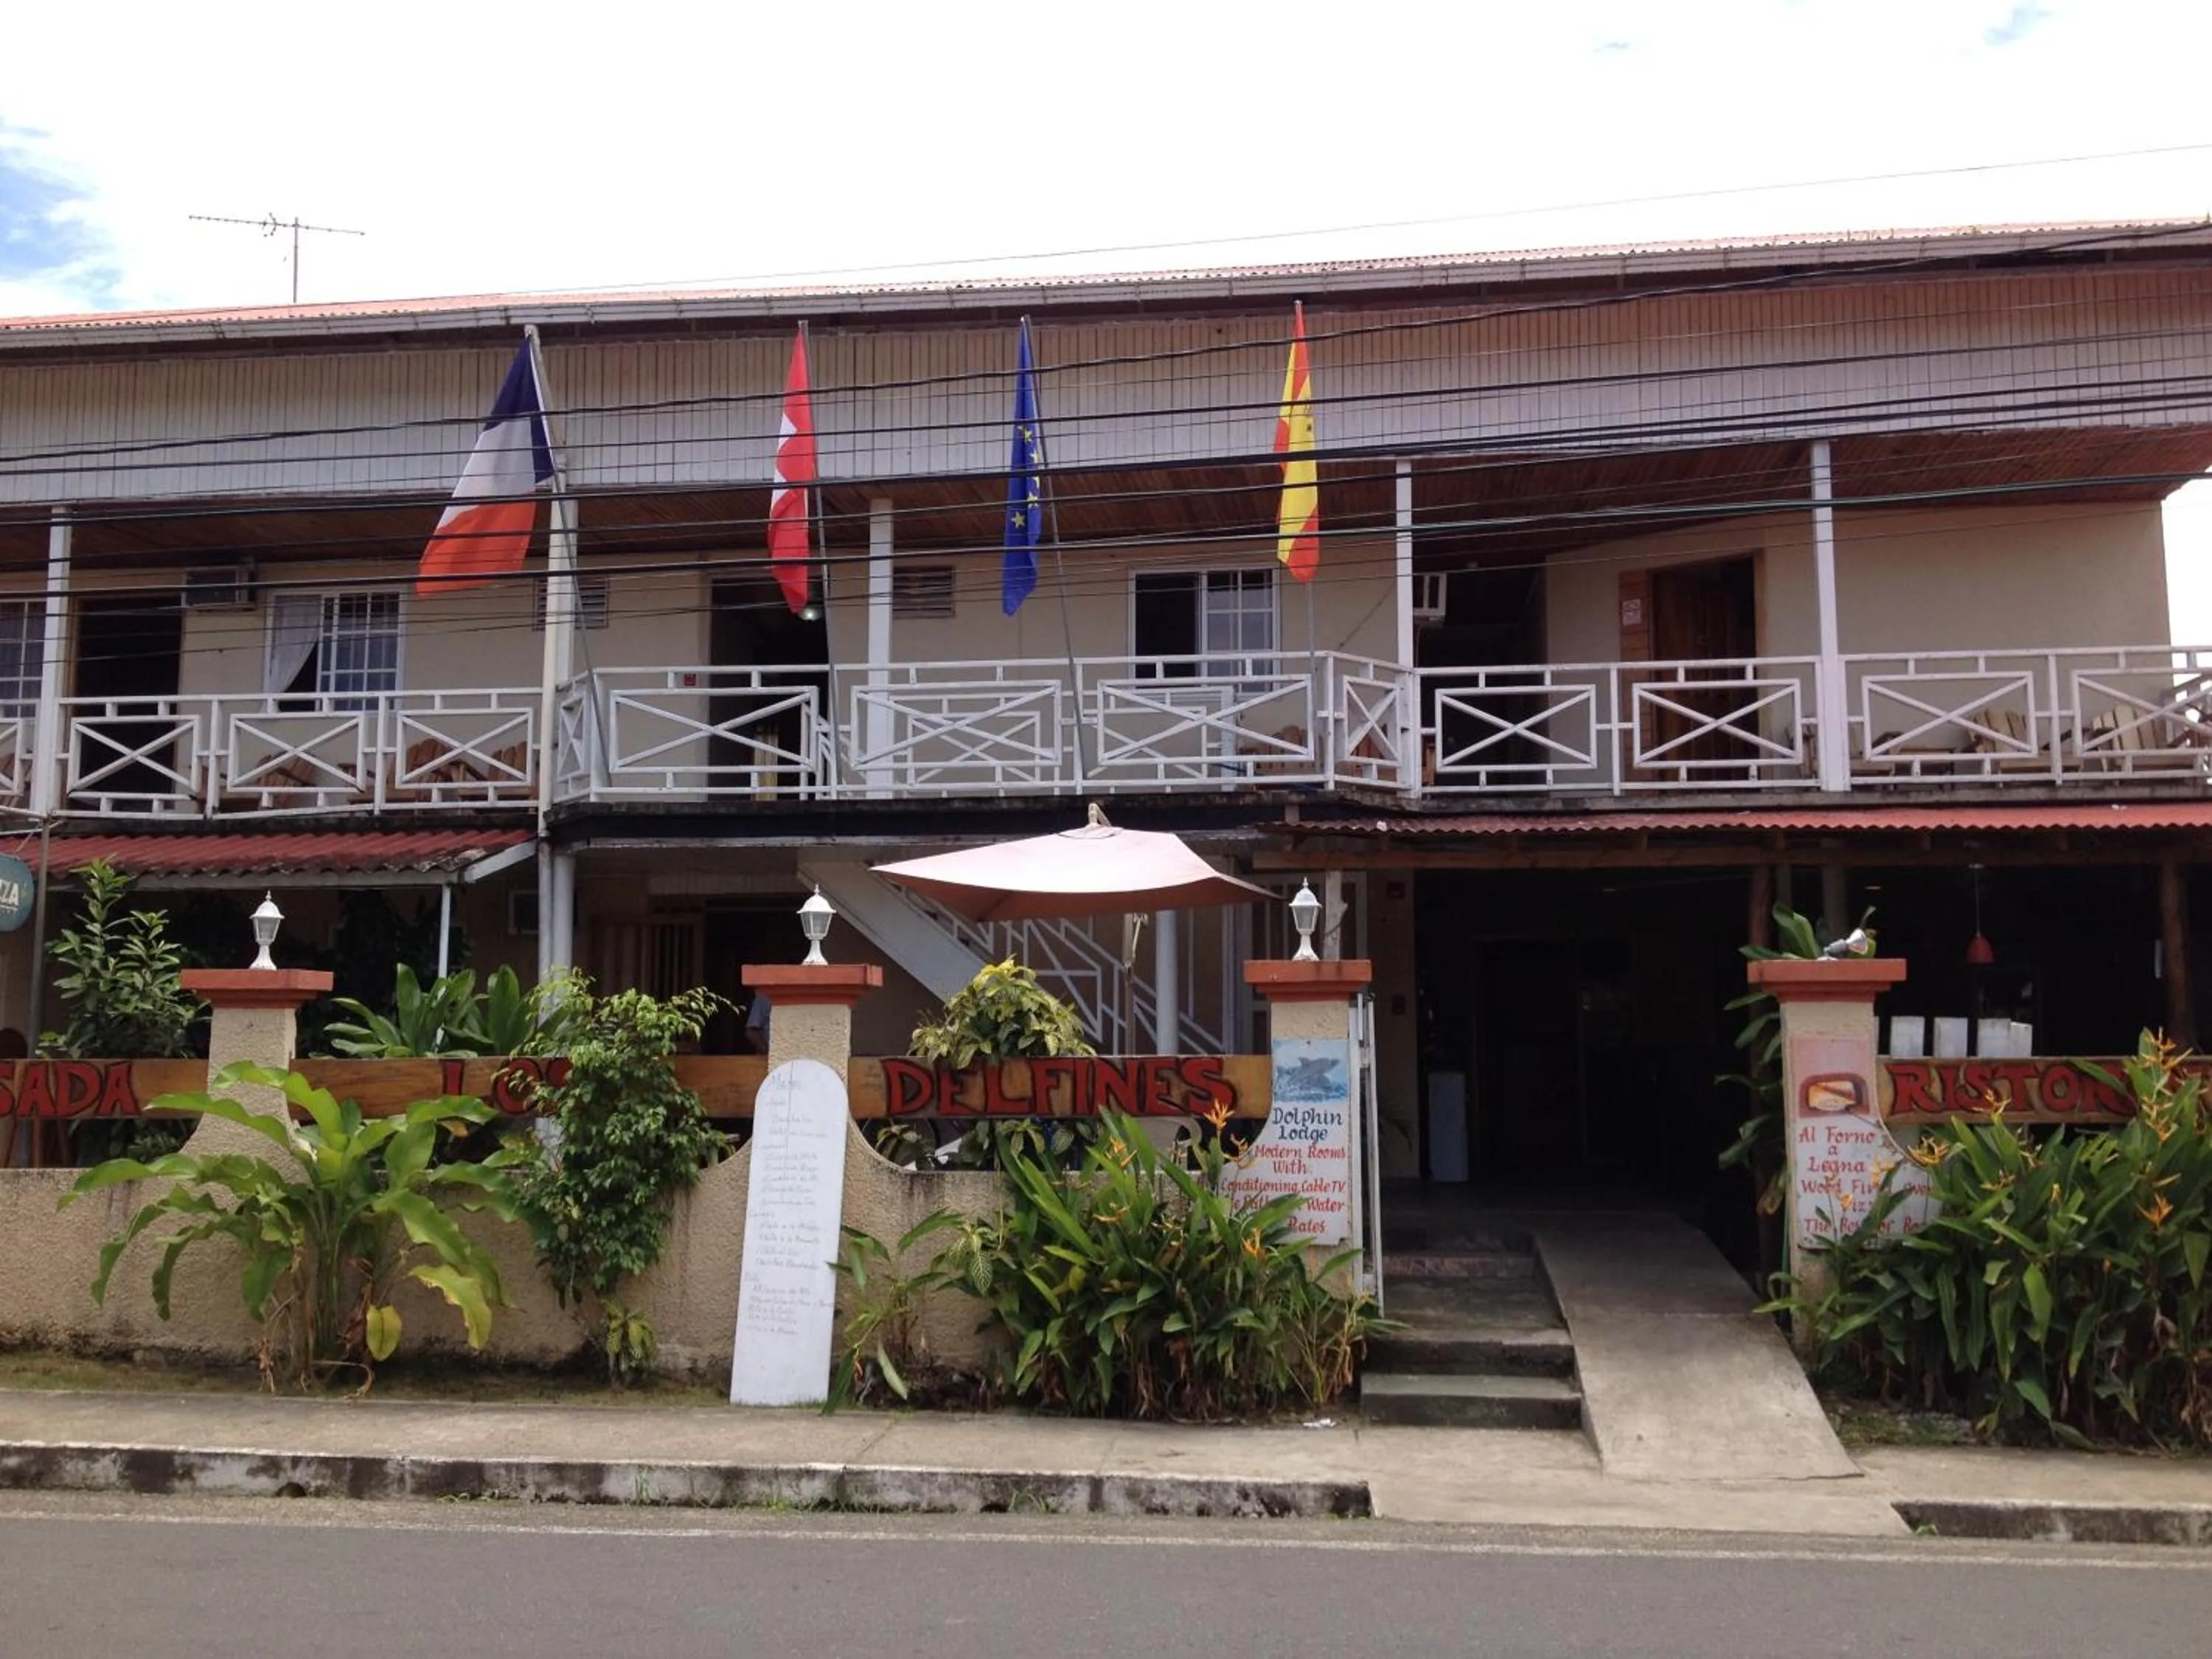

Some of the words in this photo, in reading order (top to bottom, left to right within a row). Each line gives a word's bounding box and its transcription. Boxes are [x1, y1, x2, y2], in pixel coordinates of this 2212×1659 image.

[0, 879, 19, 907] ZA
[883, 1057, 1239, 1116] DELFINES
[1272, 1107, 1343, 1128] Dolphin
[1278, 1125, 1328, 1142] Lodge
[1799, 1125, 1816, 1143] Al
[1825, 1126, 1877, 1144] Forno
[1255, 1144, 1303, 1158] Modern
[1307, 1144, 1346, 1159] Rooms
[1828, 1145, 1838, 1156] a
[1273, 1160, 1307, 1175] With
[1807, 1155, 1865, 1174] Legna
[1307, 1197, 1346, 1212] Water
